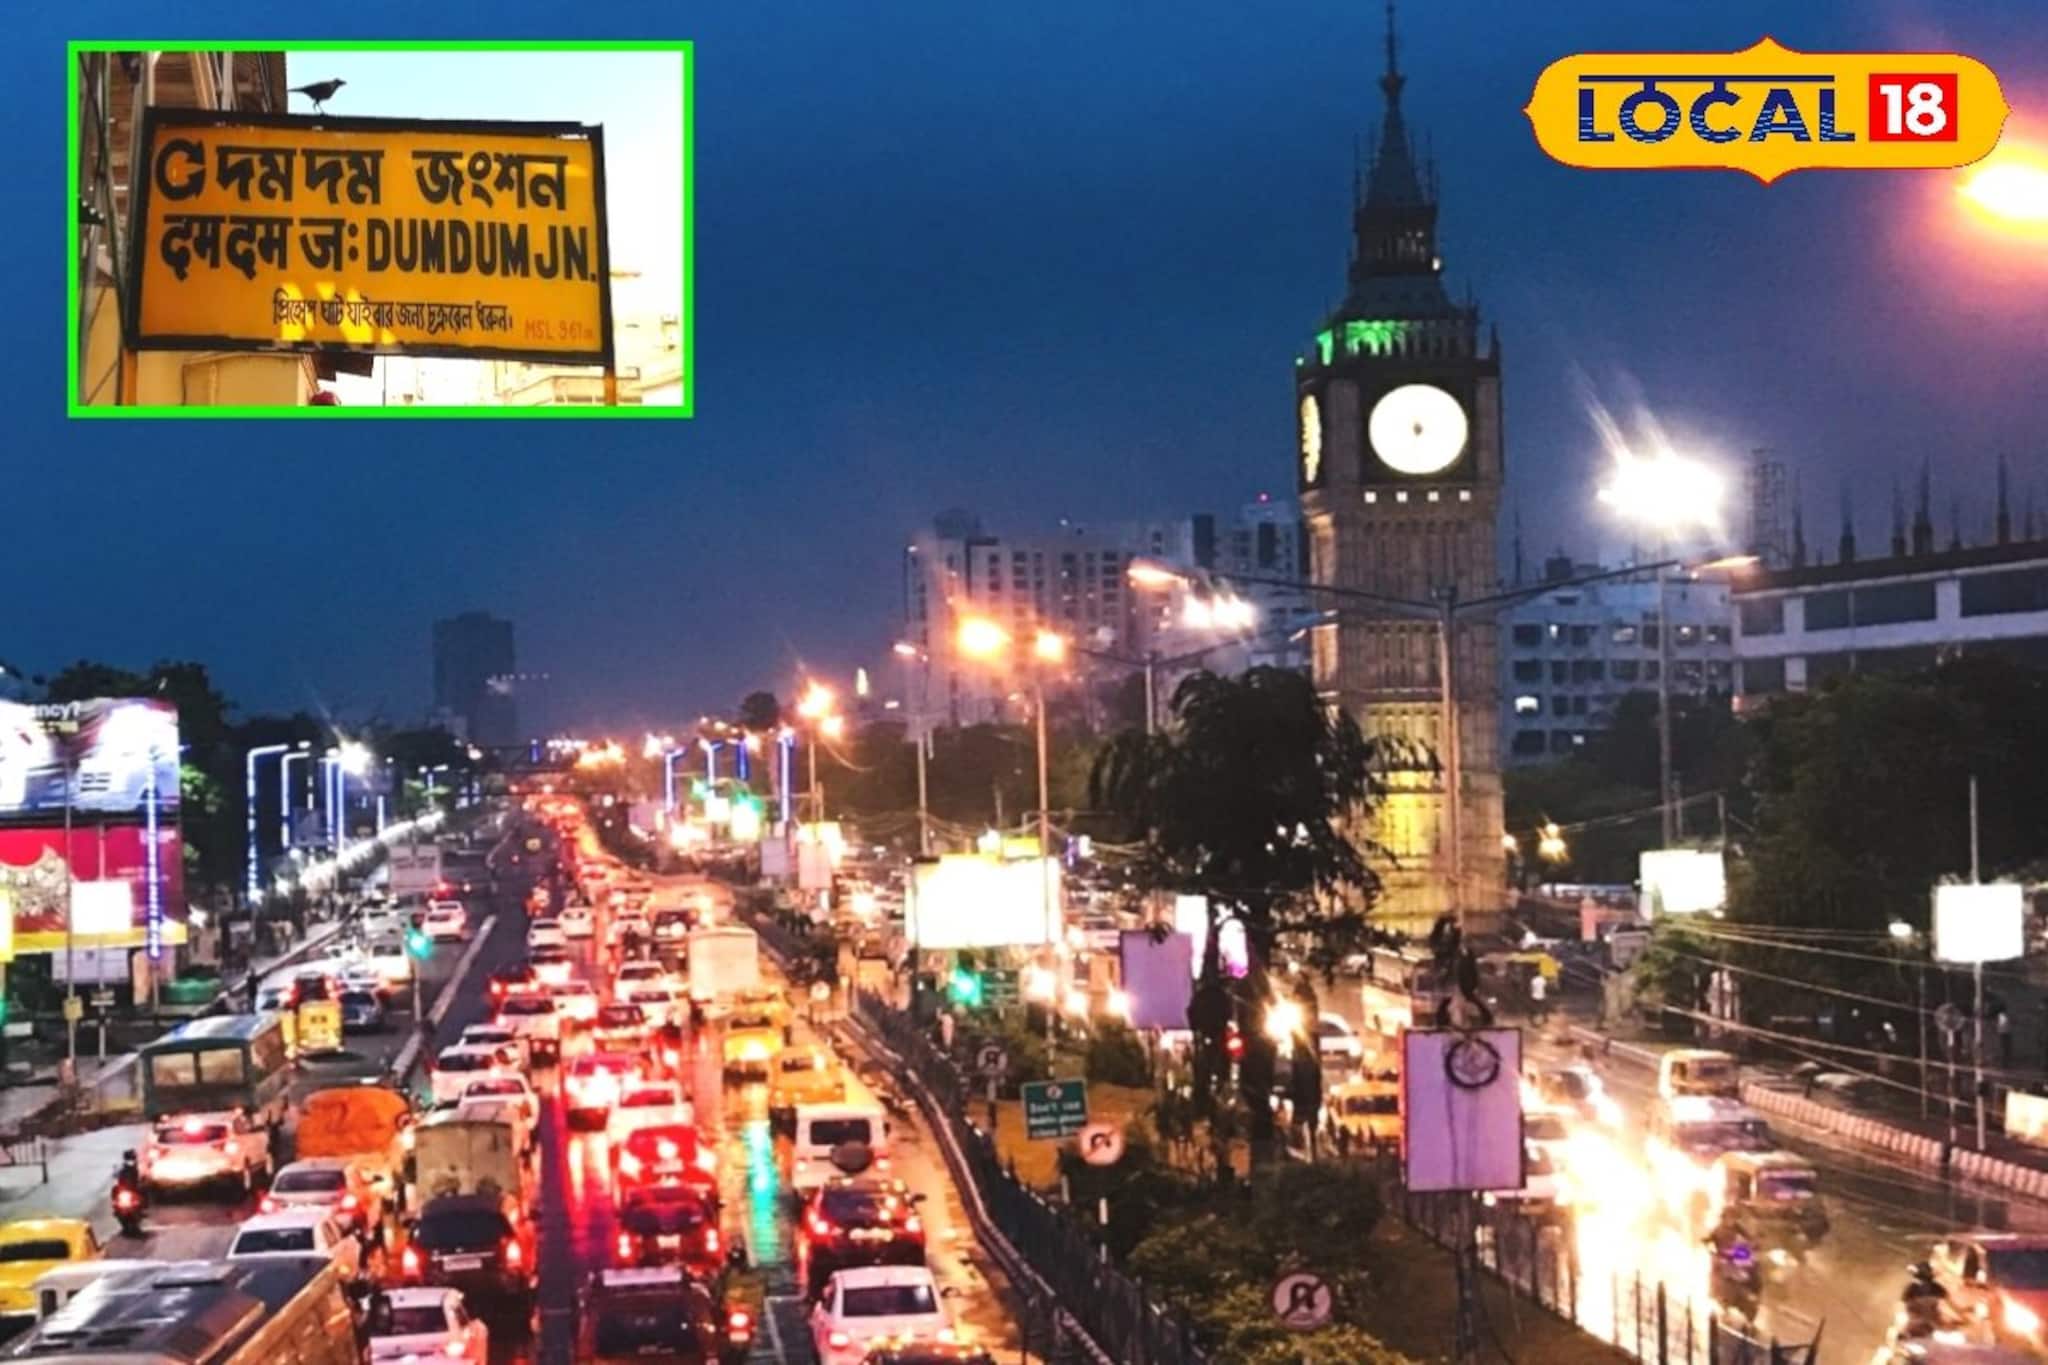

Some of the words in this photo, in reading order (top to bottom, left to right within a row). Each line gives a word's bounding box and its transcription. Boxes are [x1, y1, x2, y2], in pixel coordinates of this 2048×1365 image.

[412, 150, 569, 211] জংশন
[367, 218, 530, 278] DUMDUM
[534, 225, 597, 282] JN.
